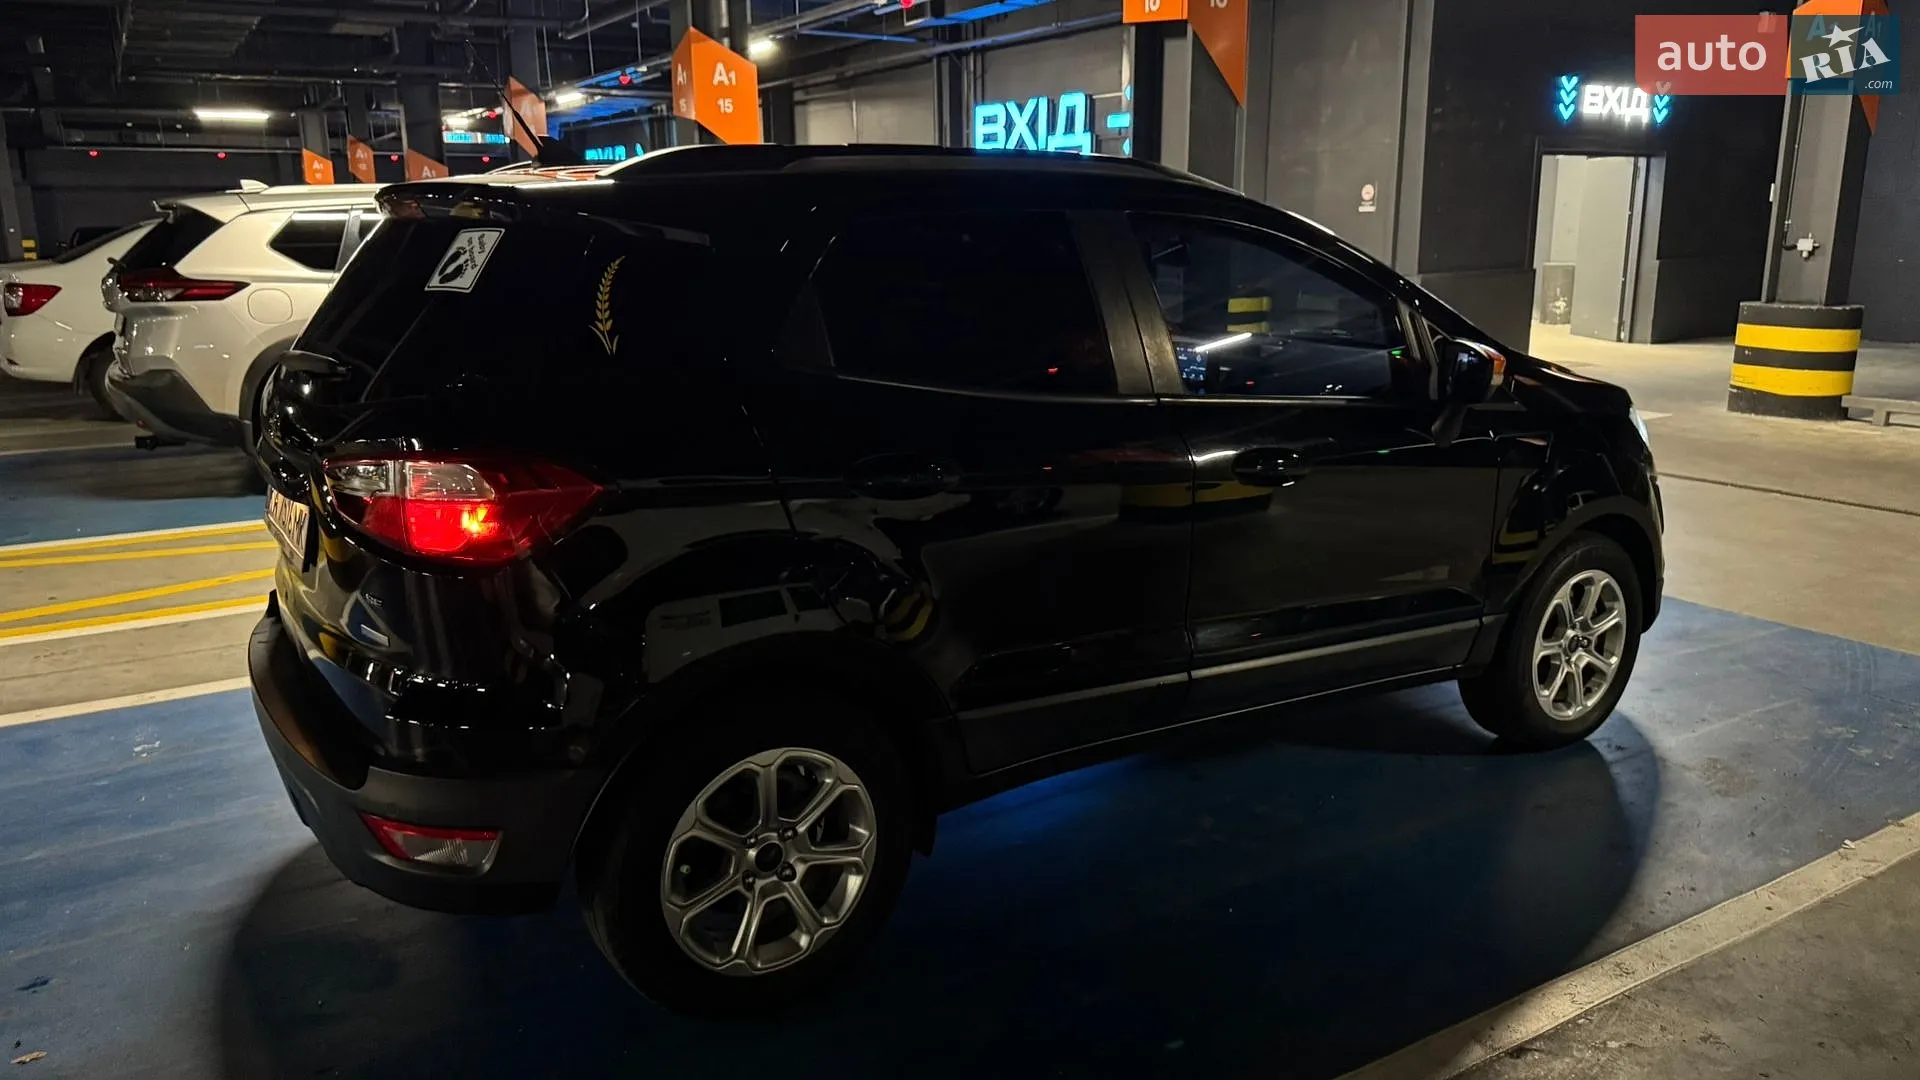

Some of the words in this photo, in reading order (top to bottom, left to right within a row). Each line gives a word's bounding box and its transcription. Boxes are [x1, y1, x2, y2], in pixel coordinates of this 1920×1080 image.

[712, 61, 737, 87] A1
[717, 98, 734, 113] 15
[1582, 84, 1650, 123] ВХІД
[975, 91, 1092, 156] ВХІД
